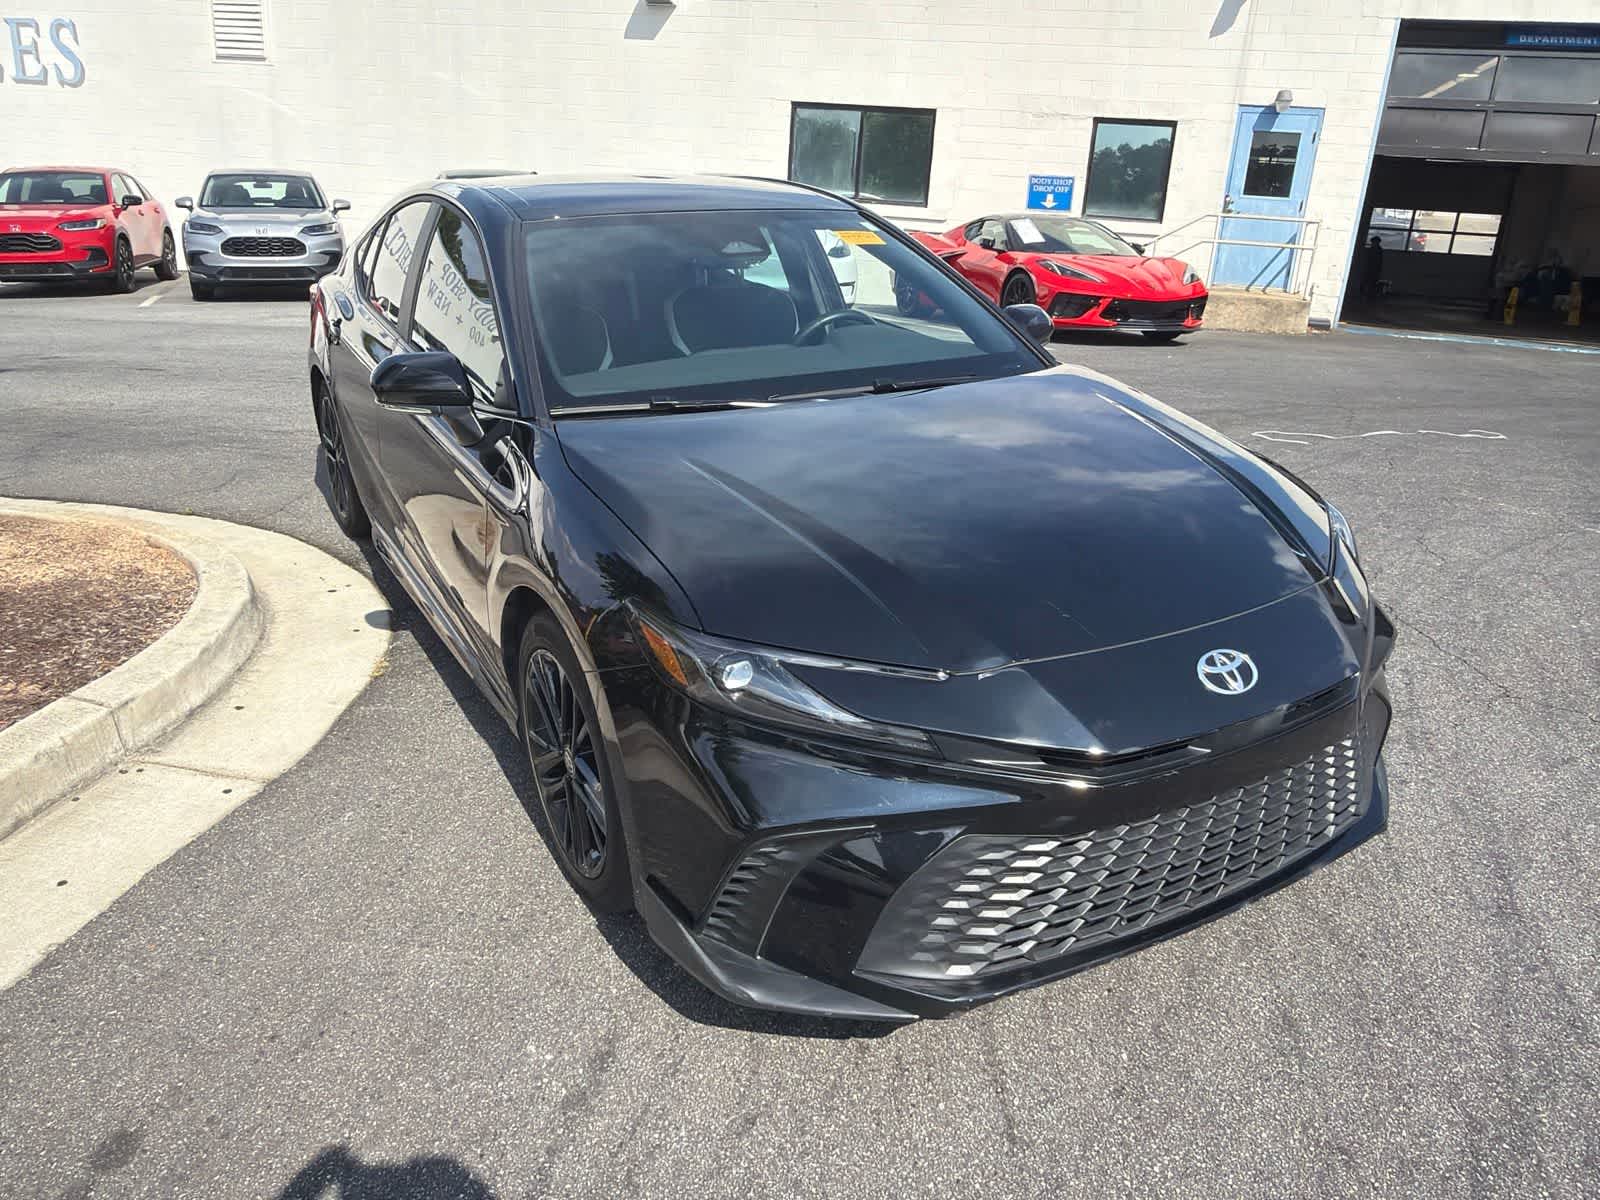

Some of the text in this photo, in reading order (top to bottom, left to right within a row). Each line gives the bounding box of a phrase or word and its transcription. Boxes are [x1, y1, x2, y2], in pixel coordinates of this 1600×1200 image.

[1519, 34, 1598, 45] DEPARTMENT
[0, 17, 86, 88] ES
[1031, 177, 1073, 186] BODY SHOP
[1054, 185, 1070, 193] OFF
